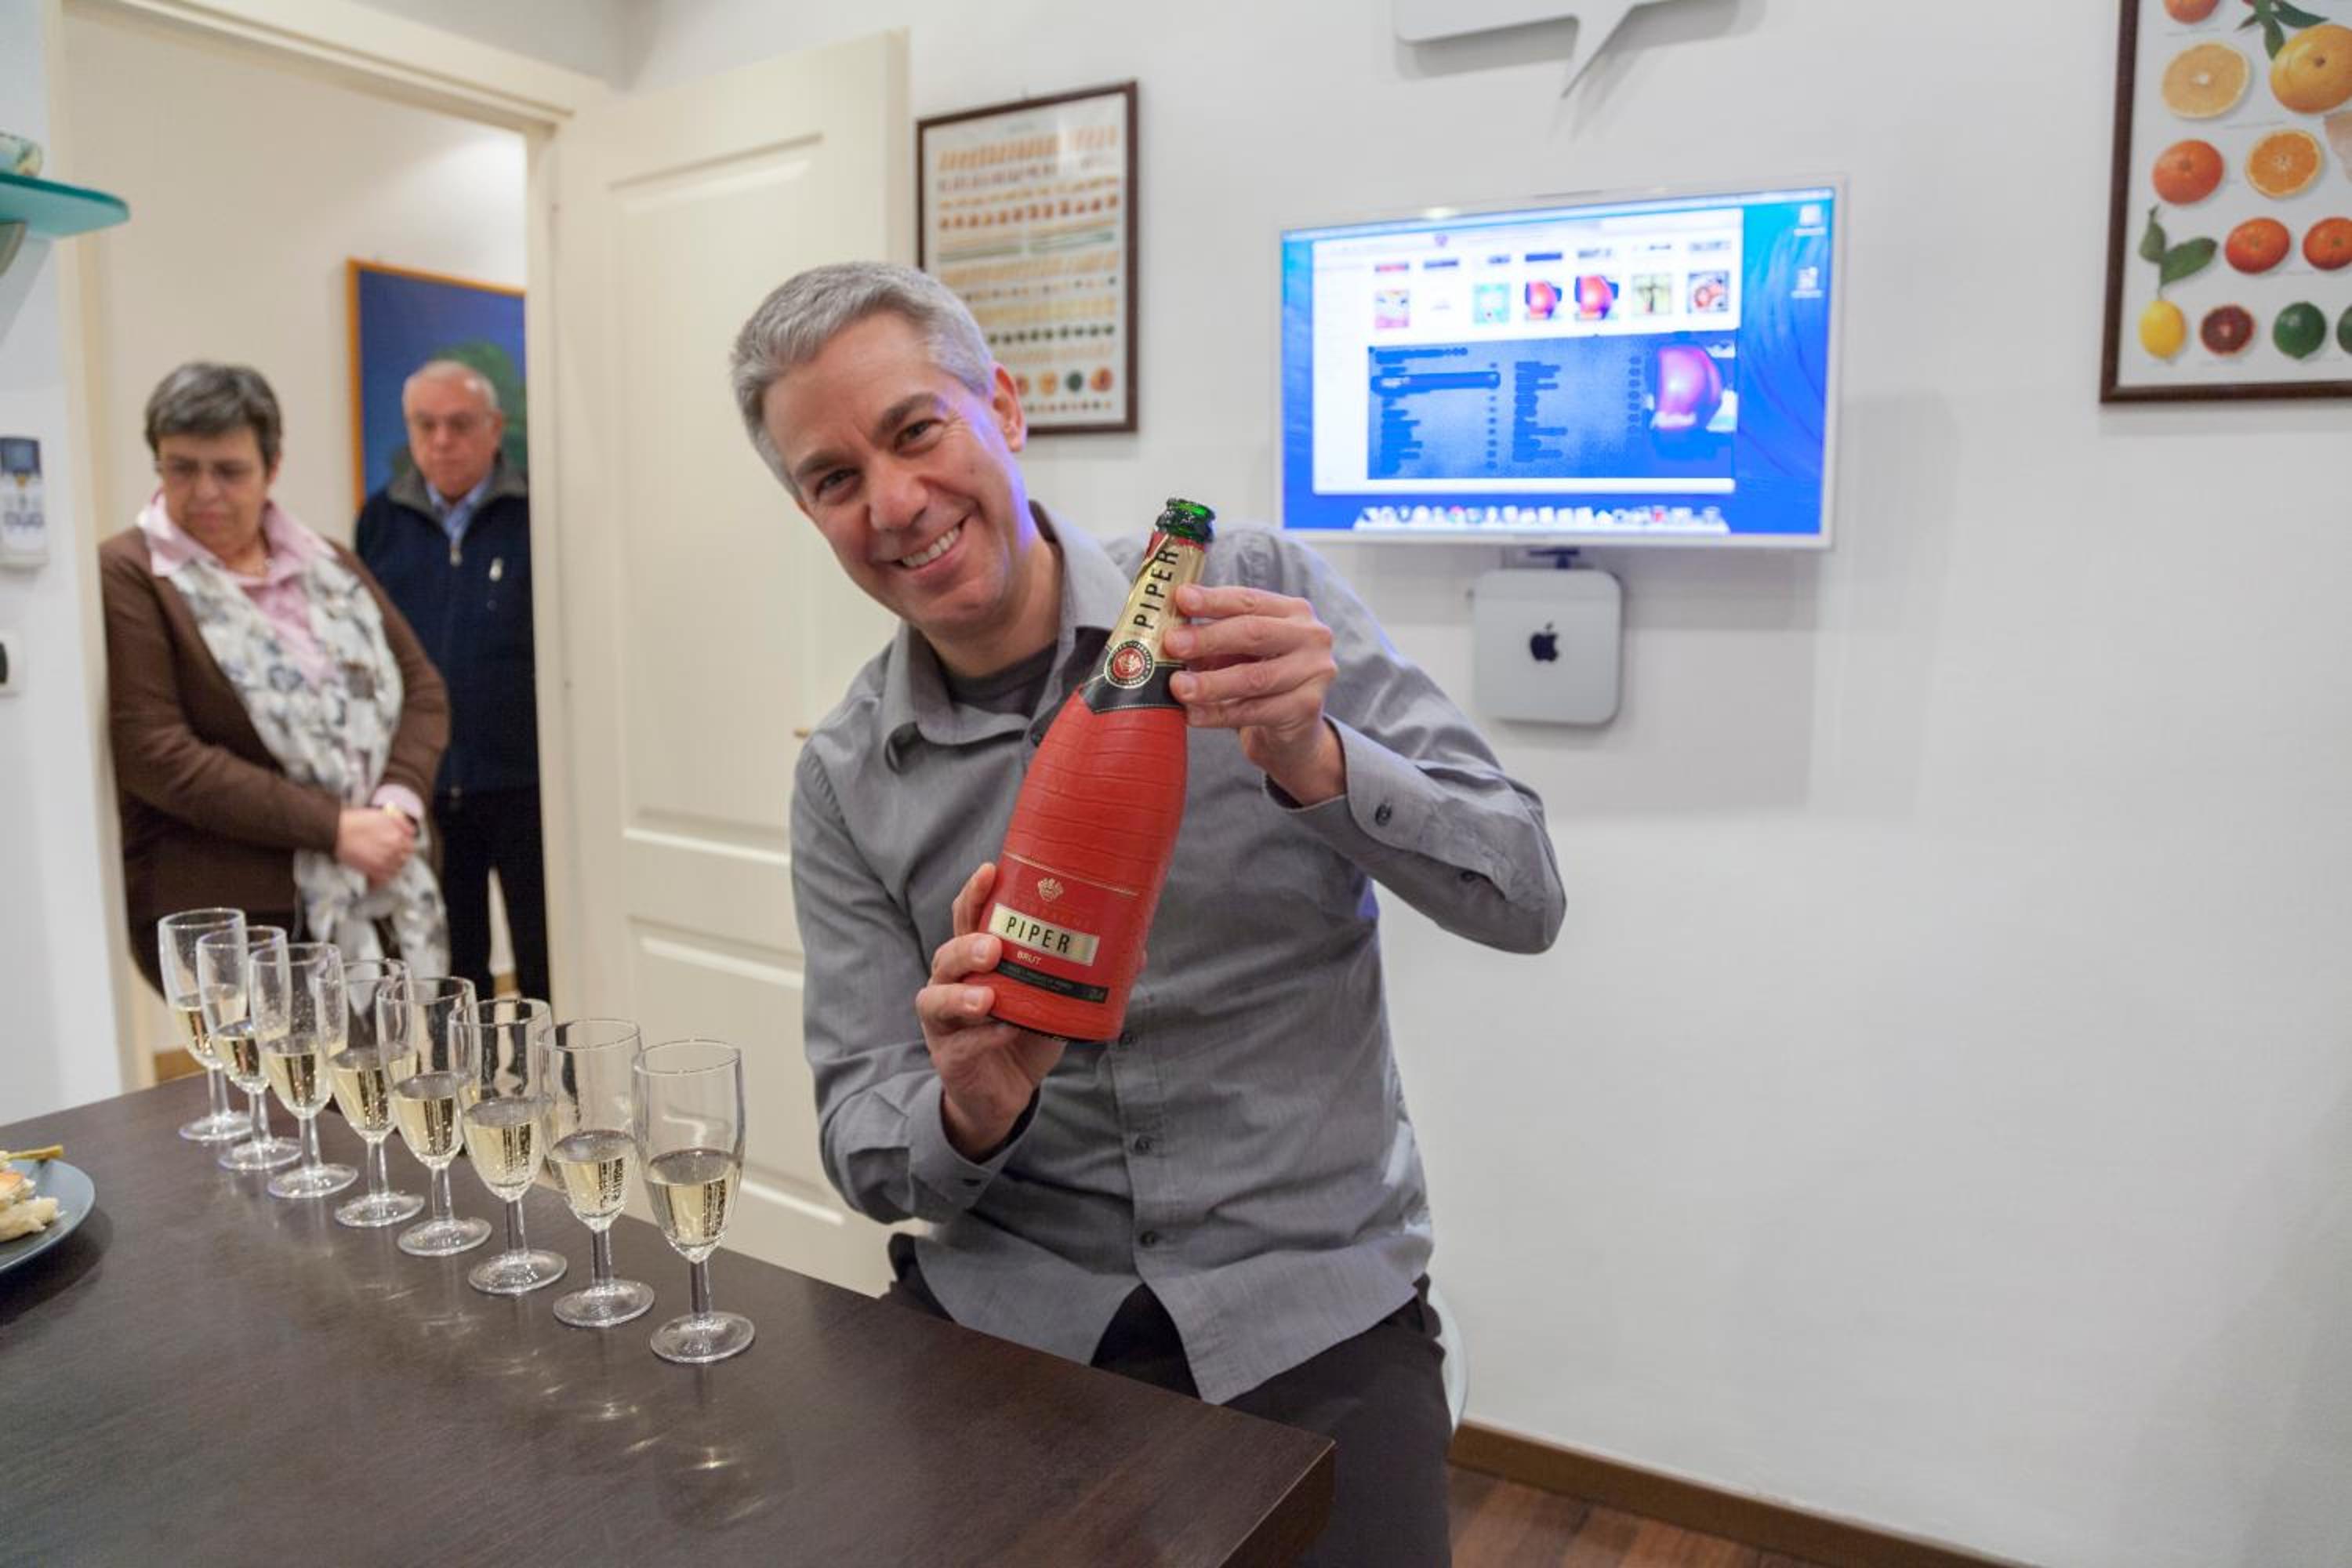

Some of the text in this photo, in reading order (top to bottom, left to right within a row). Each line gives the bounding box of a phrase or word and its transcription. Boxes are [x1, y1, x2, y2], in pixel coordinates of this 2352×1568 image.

[1133, 549, 1179, 630] PIPER
[1005, 916, 1071, 955] PIPER
[1016, 950, 1042, 966] BRUT
